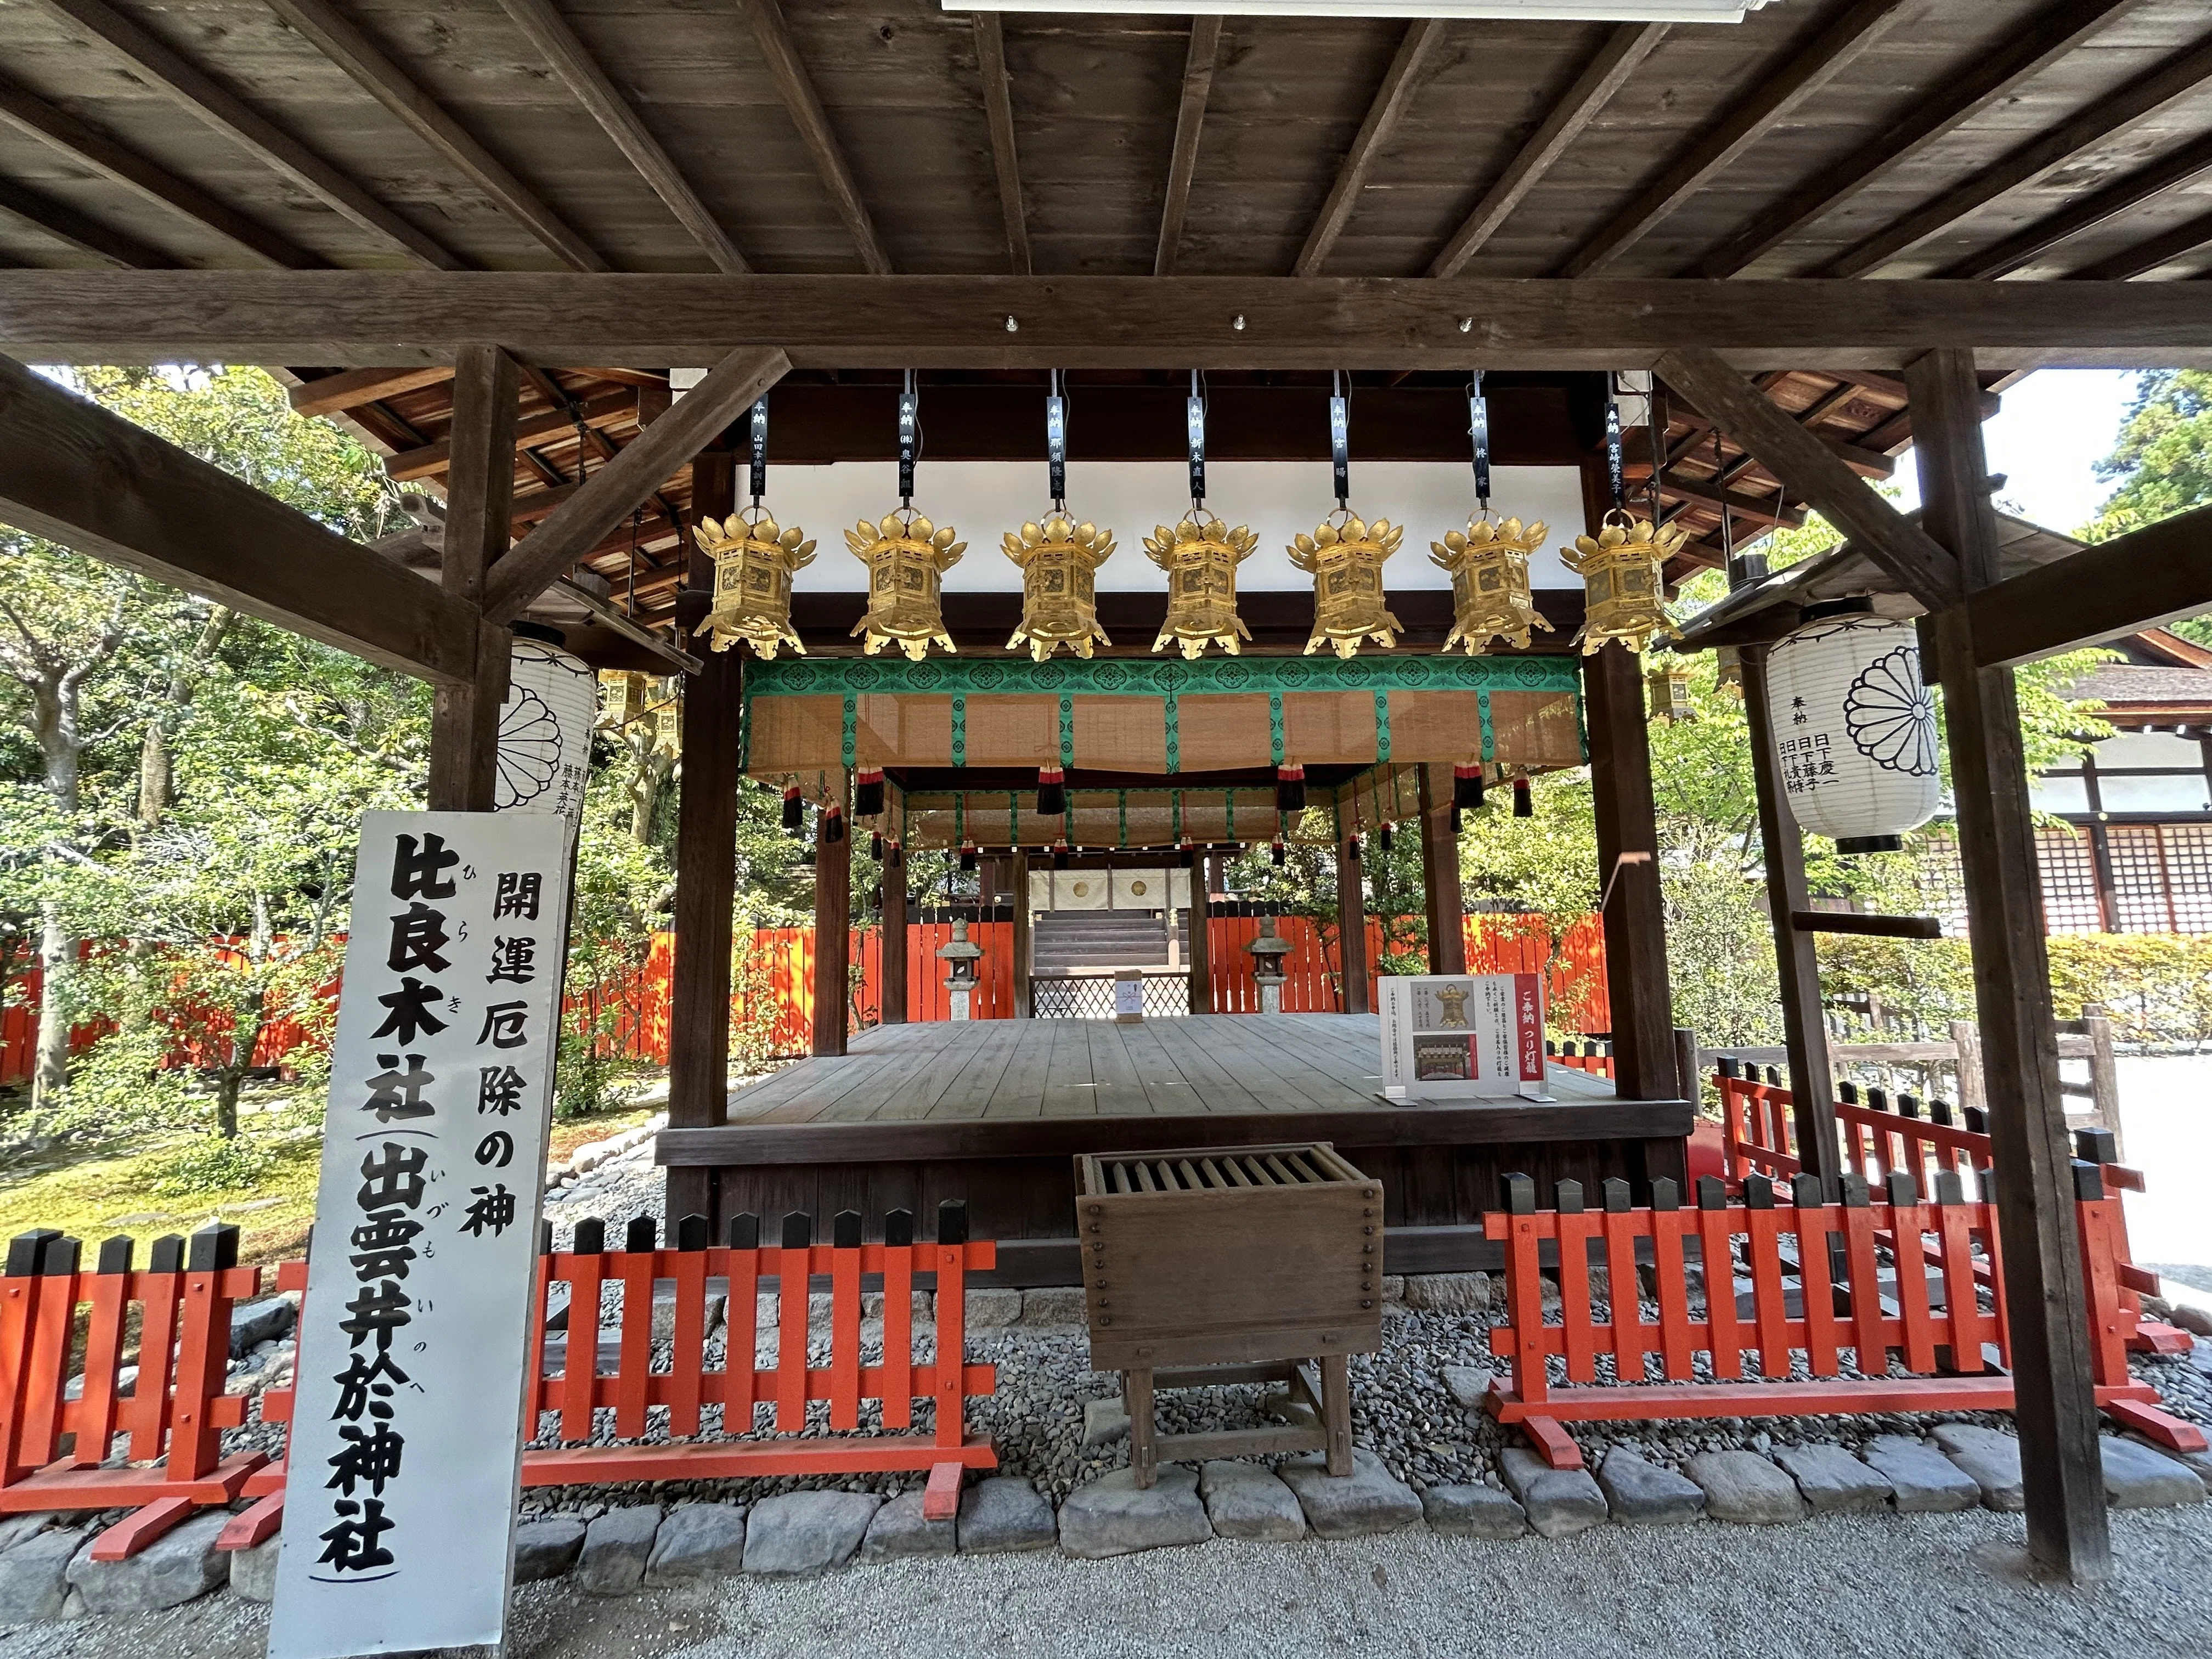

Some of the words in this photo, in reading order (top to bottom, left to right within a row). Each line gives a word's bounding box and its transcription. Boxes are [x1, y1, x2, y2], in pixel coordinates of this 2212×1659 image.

[753, 401, 765, 425] 奉納
[900, 402, 912, 426] 奉納
[1049, 405, 1060, 428] 奉納
[1190, 405, 1201, 428] 奉納
[1333, 405, 1344, 428] 奉納
[1474, 405, 1485, 428] 奉納
[1607, 410, 1618, 433] 奉納
[1190, 438, 1204, 490] 新木直人
[1791, 696, 1807, 725] 奉納
[1814, 733, 1839, 786] 日下慶一
[1522, 991, 1534, 1024] ご奉納
[457, 872, 543, 1237] 開運厄除の神
